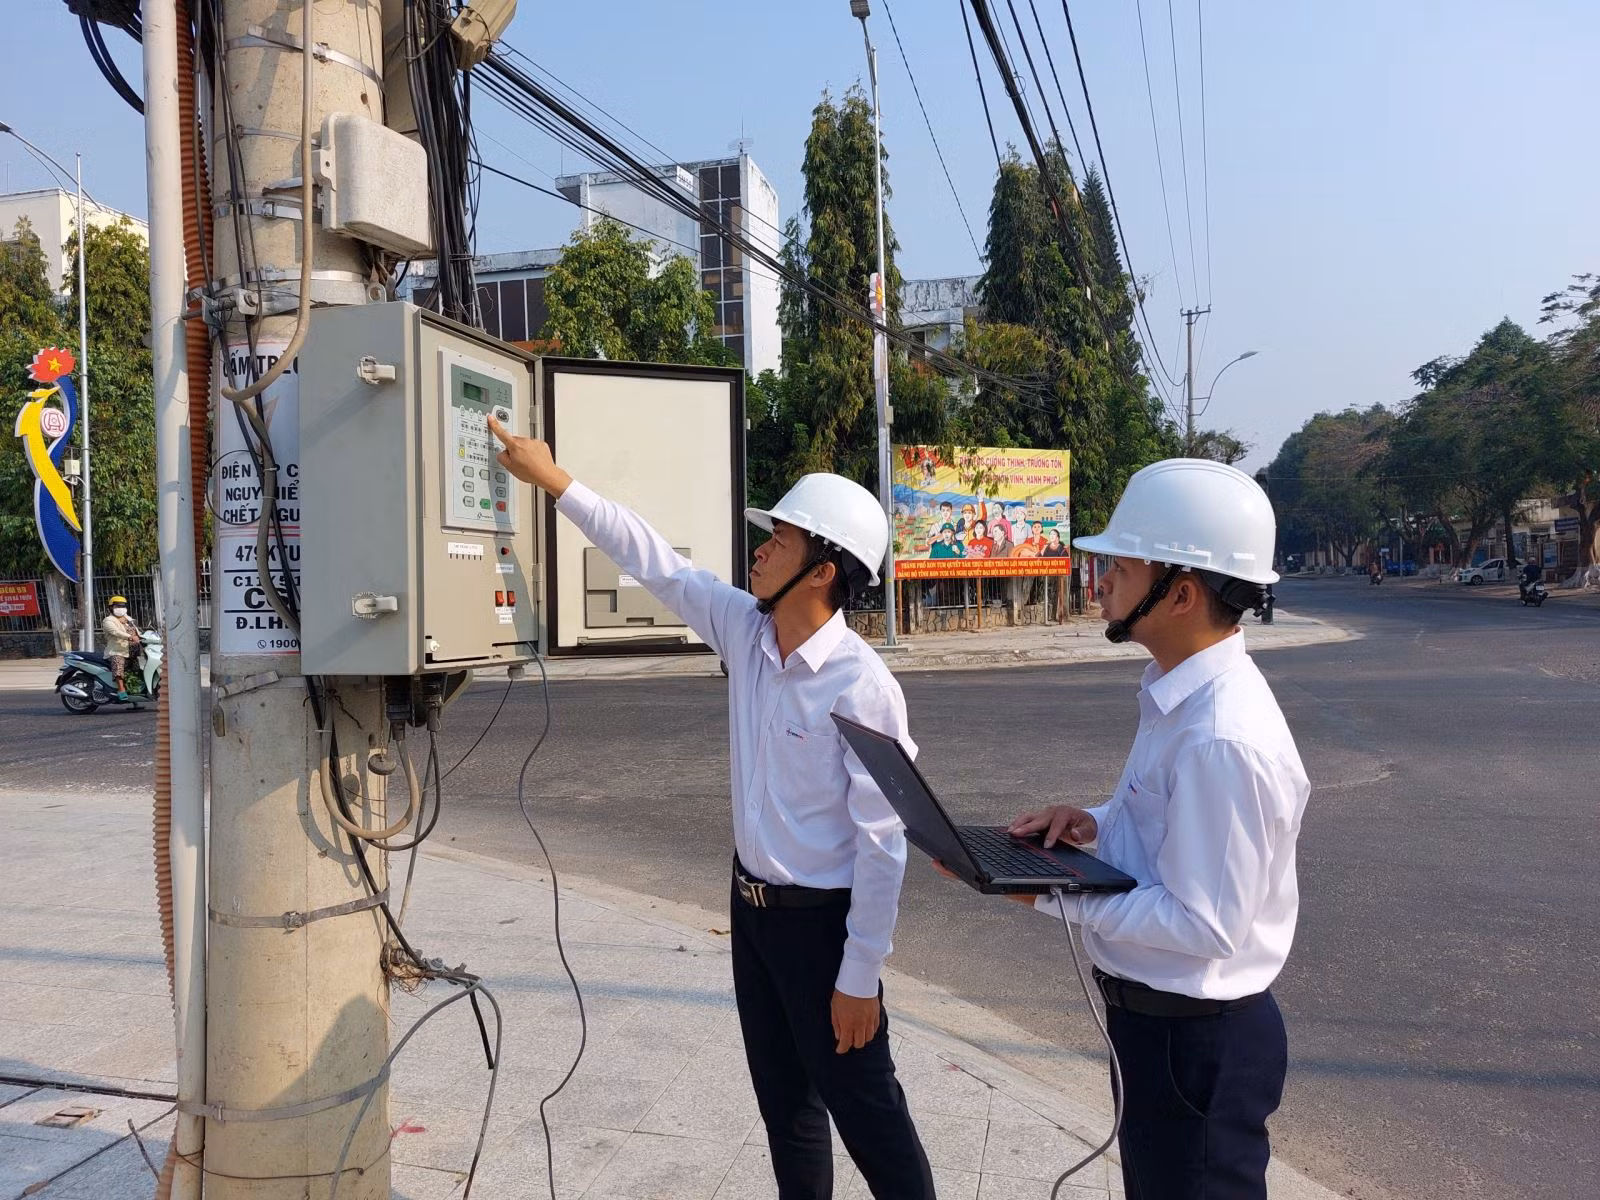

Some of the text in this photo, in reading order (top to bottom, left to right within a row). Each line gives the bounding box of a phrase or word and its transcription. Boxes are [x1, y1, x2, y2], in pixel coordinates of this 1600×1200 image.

[256, 350, 298, 374] TR
[222, 461, 251, 481] ĐIỆN
[226, 486, 261, 502] NGUY
[223, 503, 258, 522] CHẾT
[236, 616, 289, 630] Đ.LH
